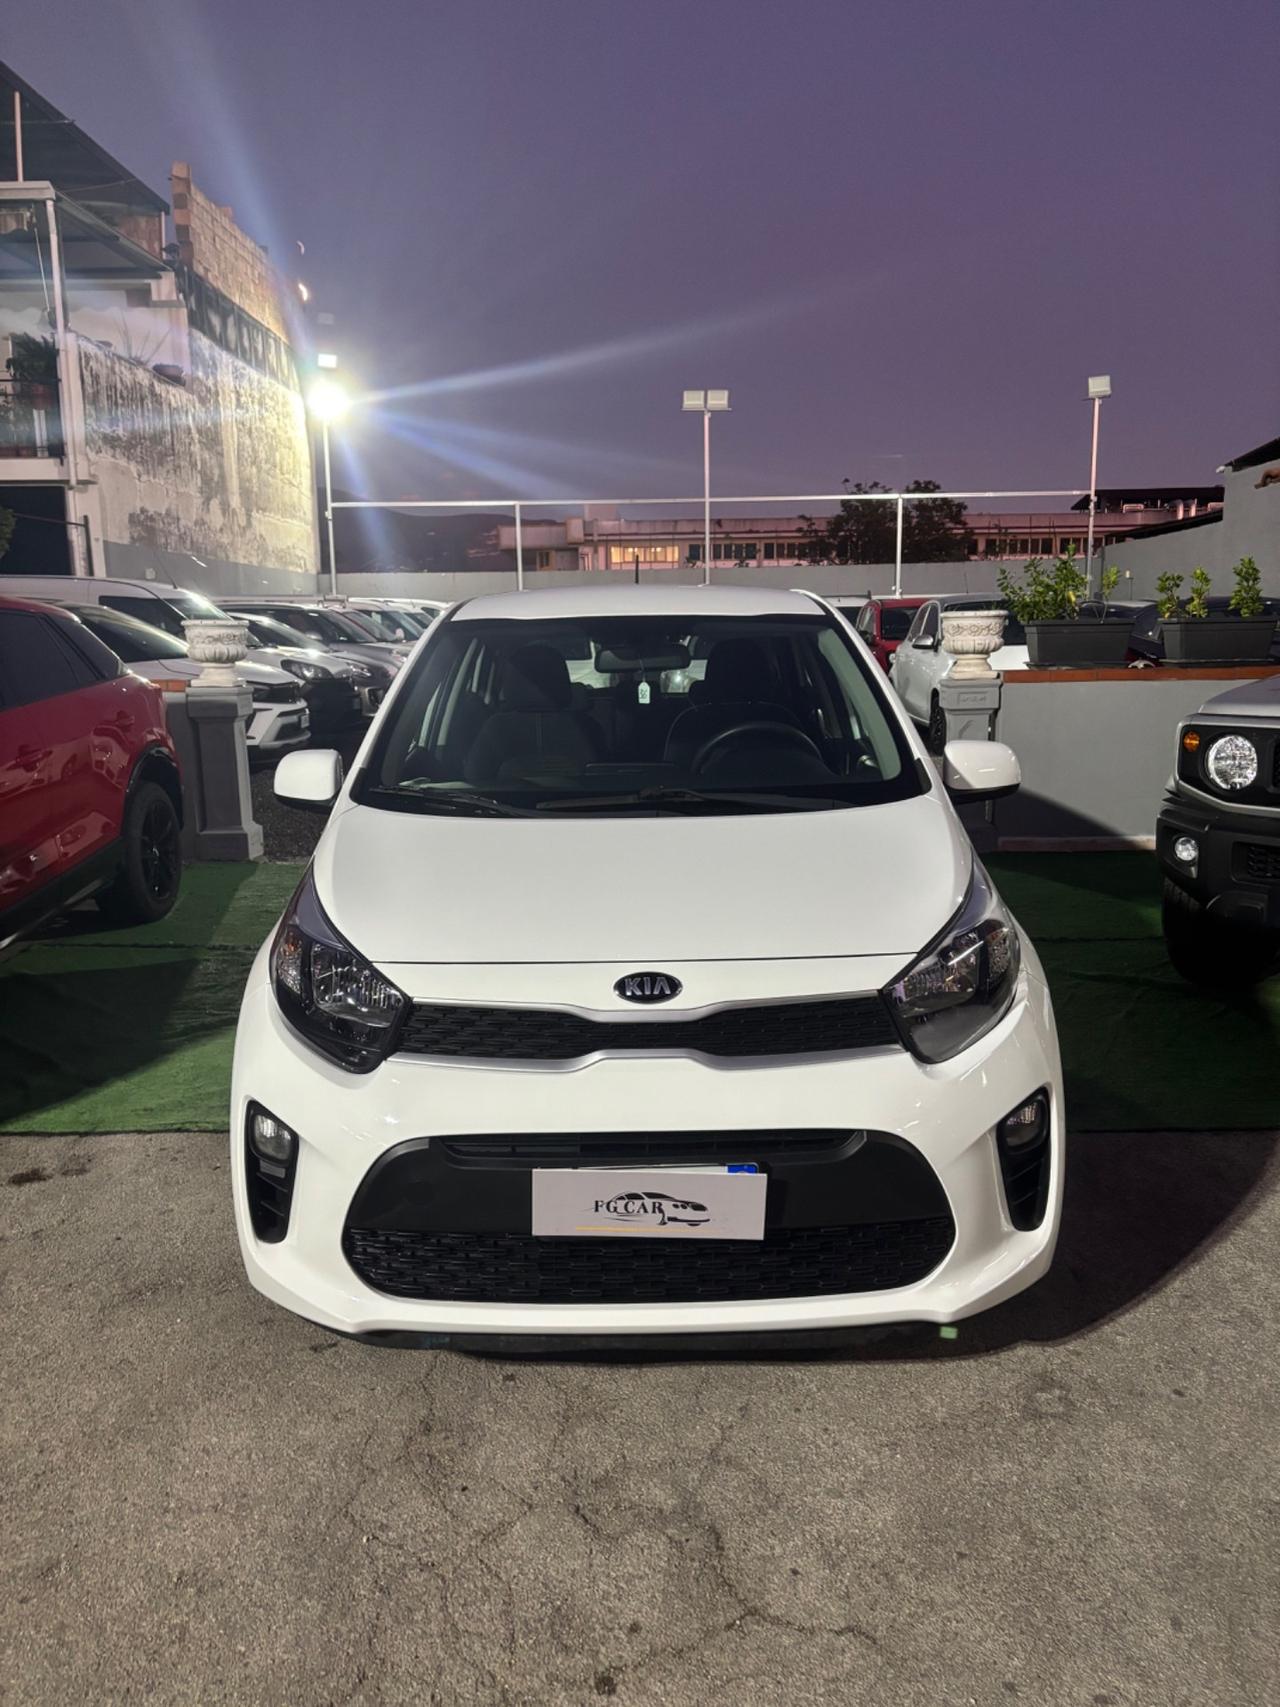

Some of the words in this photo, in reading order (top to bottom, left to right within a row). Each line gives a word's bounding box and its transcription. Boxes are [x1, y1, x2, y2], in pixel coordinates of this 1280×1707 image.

[624, 976, 671, 996] KIA
[594, 1200, 618, 1214] FG
[624, 1200, 664, 1214] CAR
